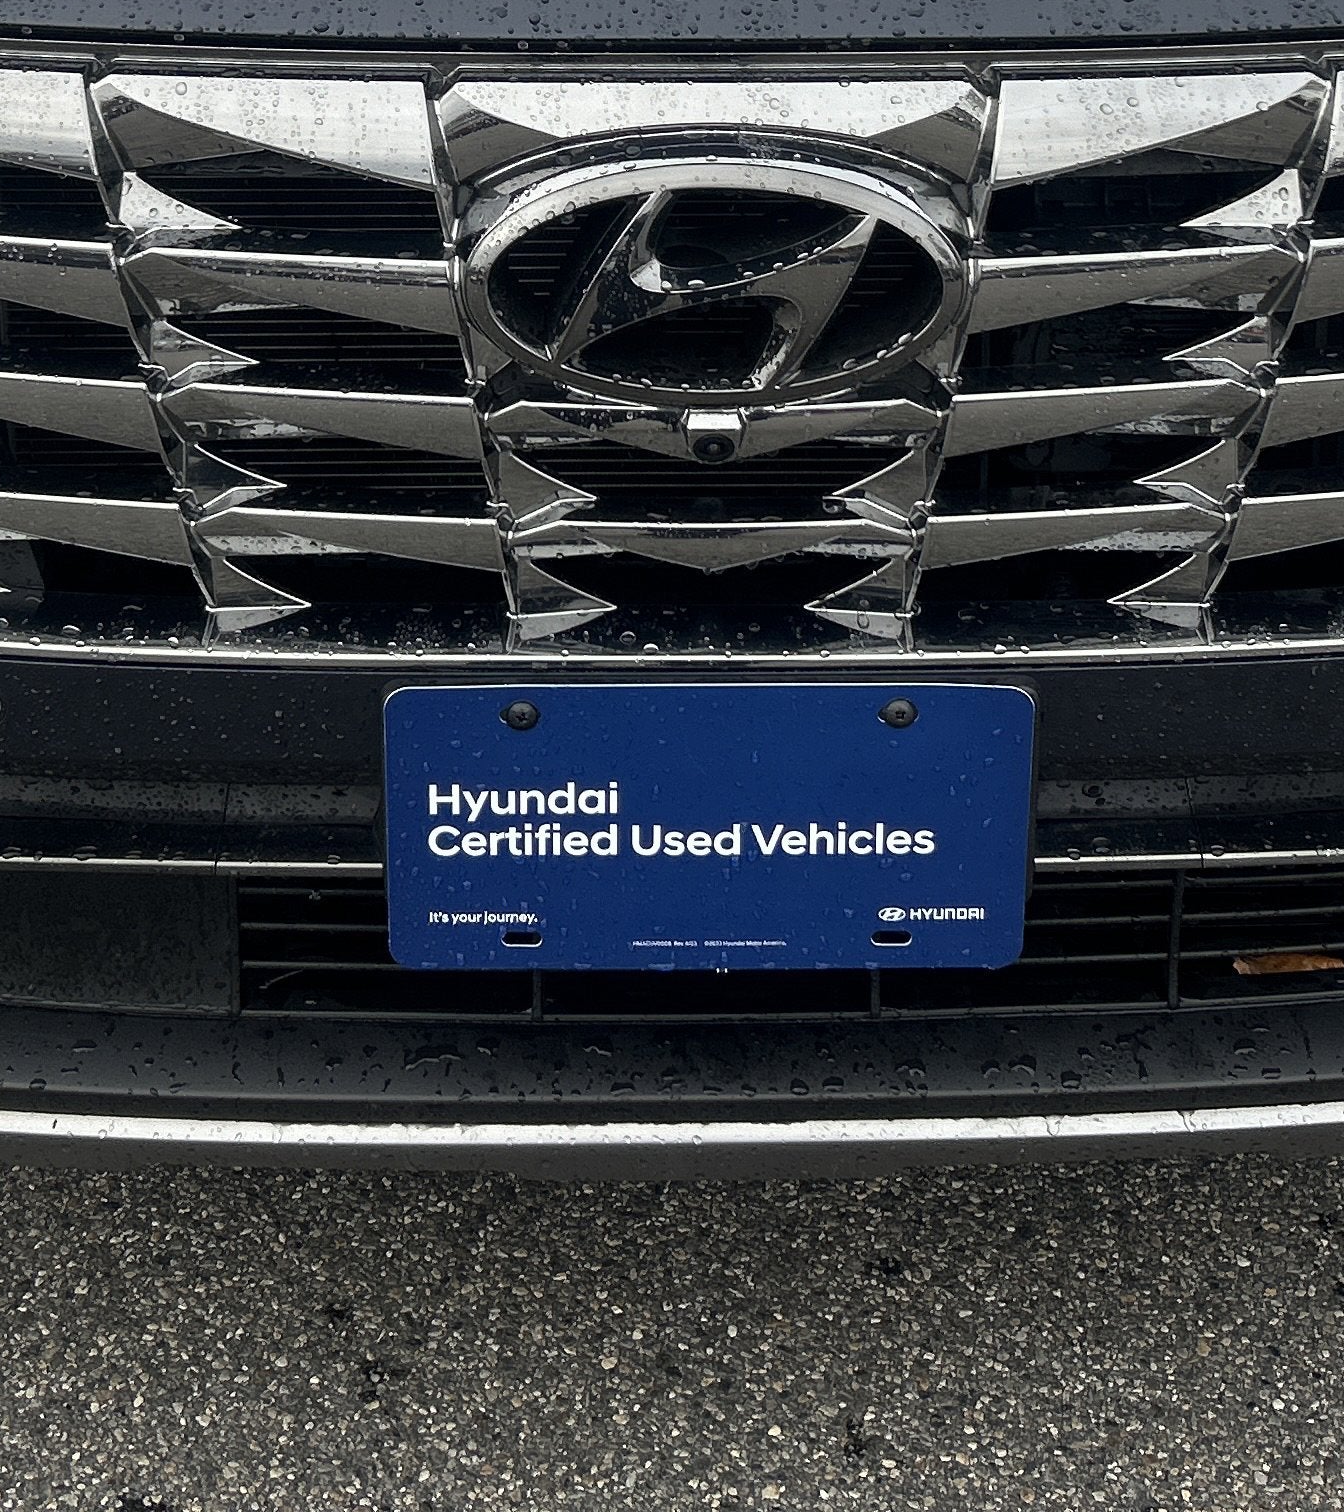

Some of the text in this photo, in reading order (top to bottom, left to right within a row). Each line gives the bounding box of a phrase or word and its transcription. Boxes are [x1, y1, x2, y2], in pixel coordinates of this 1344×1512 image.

[429, 782, 618, 822] Hyundai
[428, 822, 935, 857] Certified Used Vehicles
[429, 910, 538, 925] It's your journey.
[909, 907, 985, 921] HYUNDAI
